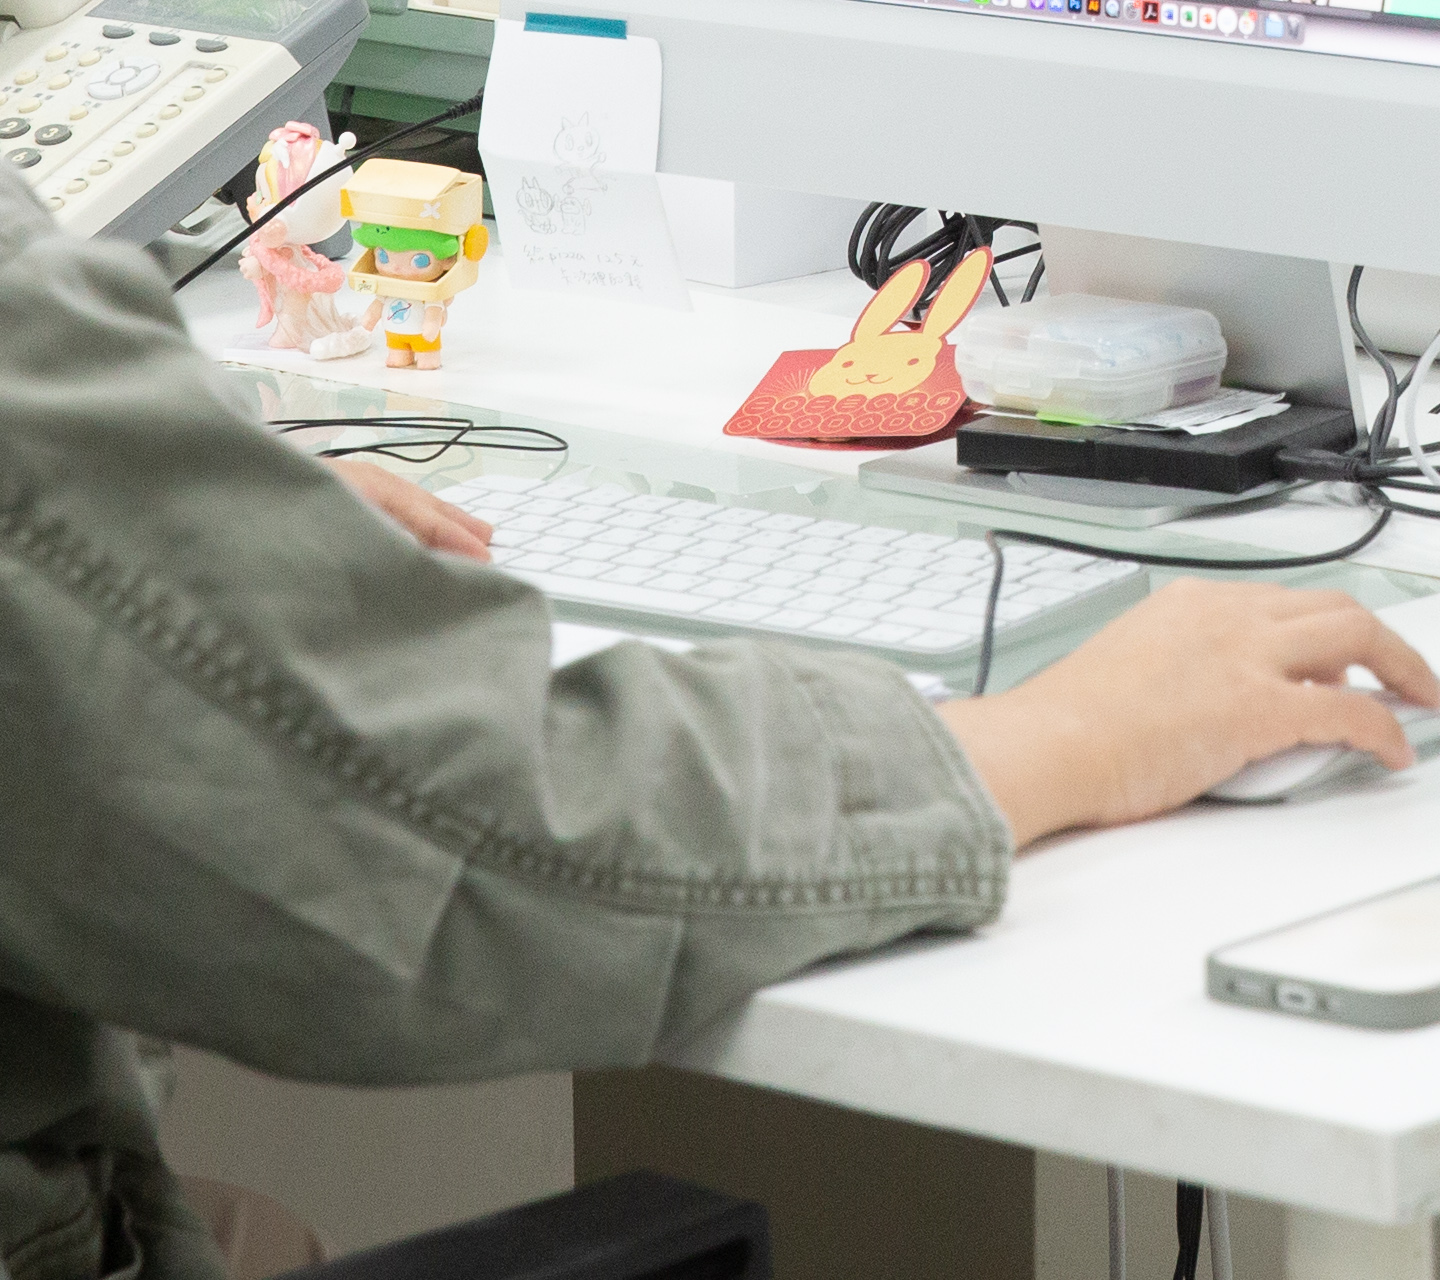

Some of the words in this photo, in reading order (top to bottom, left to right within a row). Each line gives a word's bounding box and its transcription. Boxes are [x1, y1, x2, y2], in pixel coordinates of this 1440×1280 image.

[1088, 0, 1100, 12] Ai
[4, 121, 19, 134] 2
[42, 126, 58, 140] 3
